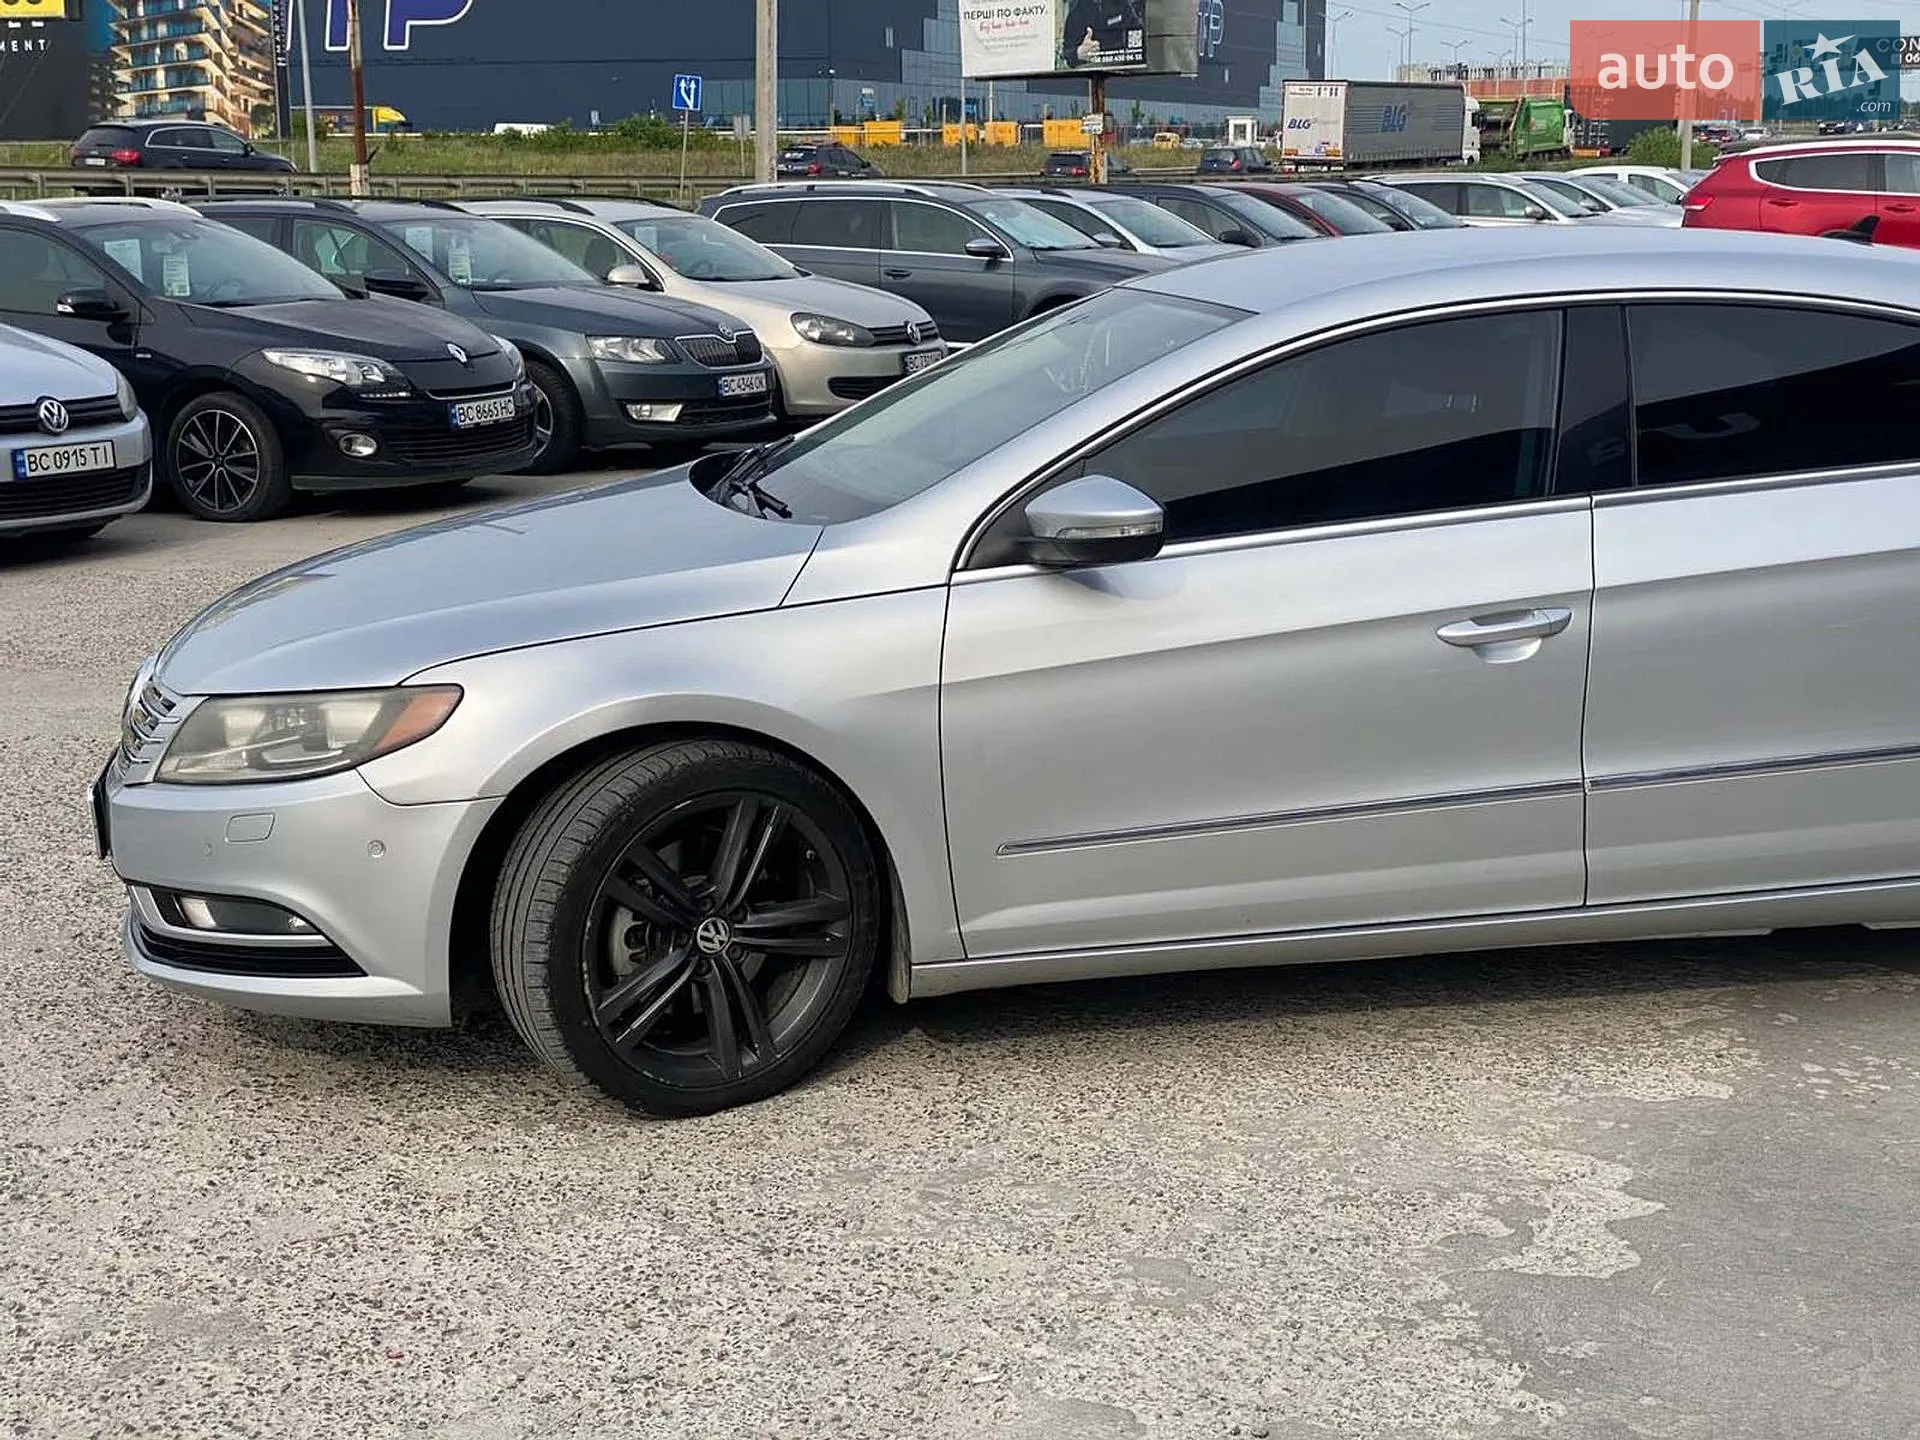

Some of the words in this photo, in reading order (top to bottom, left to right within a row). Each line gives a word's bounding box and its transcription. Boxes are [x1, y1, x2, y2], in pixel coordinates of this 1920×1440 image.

[964, 9, 994, 20] ПЕРШІ
[997, 8, 1011, 18] ПО
[1288, 118, 1312, 130] BLG
[1381, 104, 1409, 133] BLG
[27, 452, 50, 472] BC
[53, 448, 87, 469] 0915
[91, 445, 108, 465] TI
